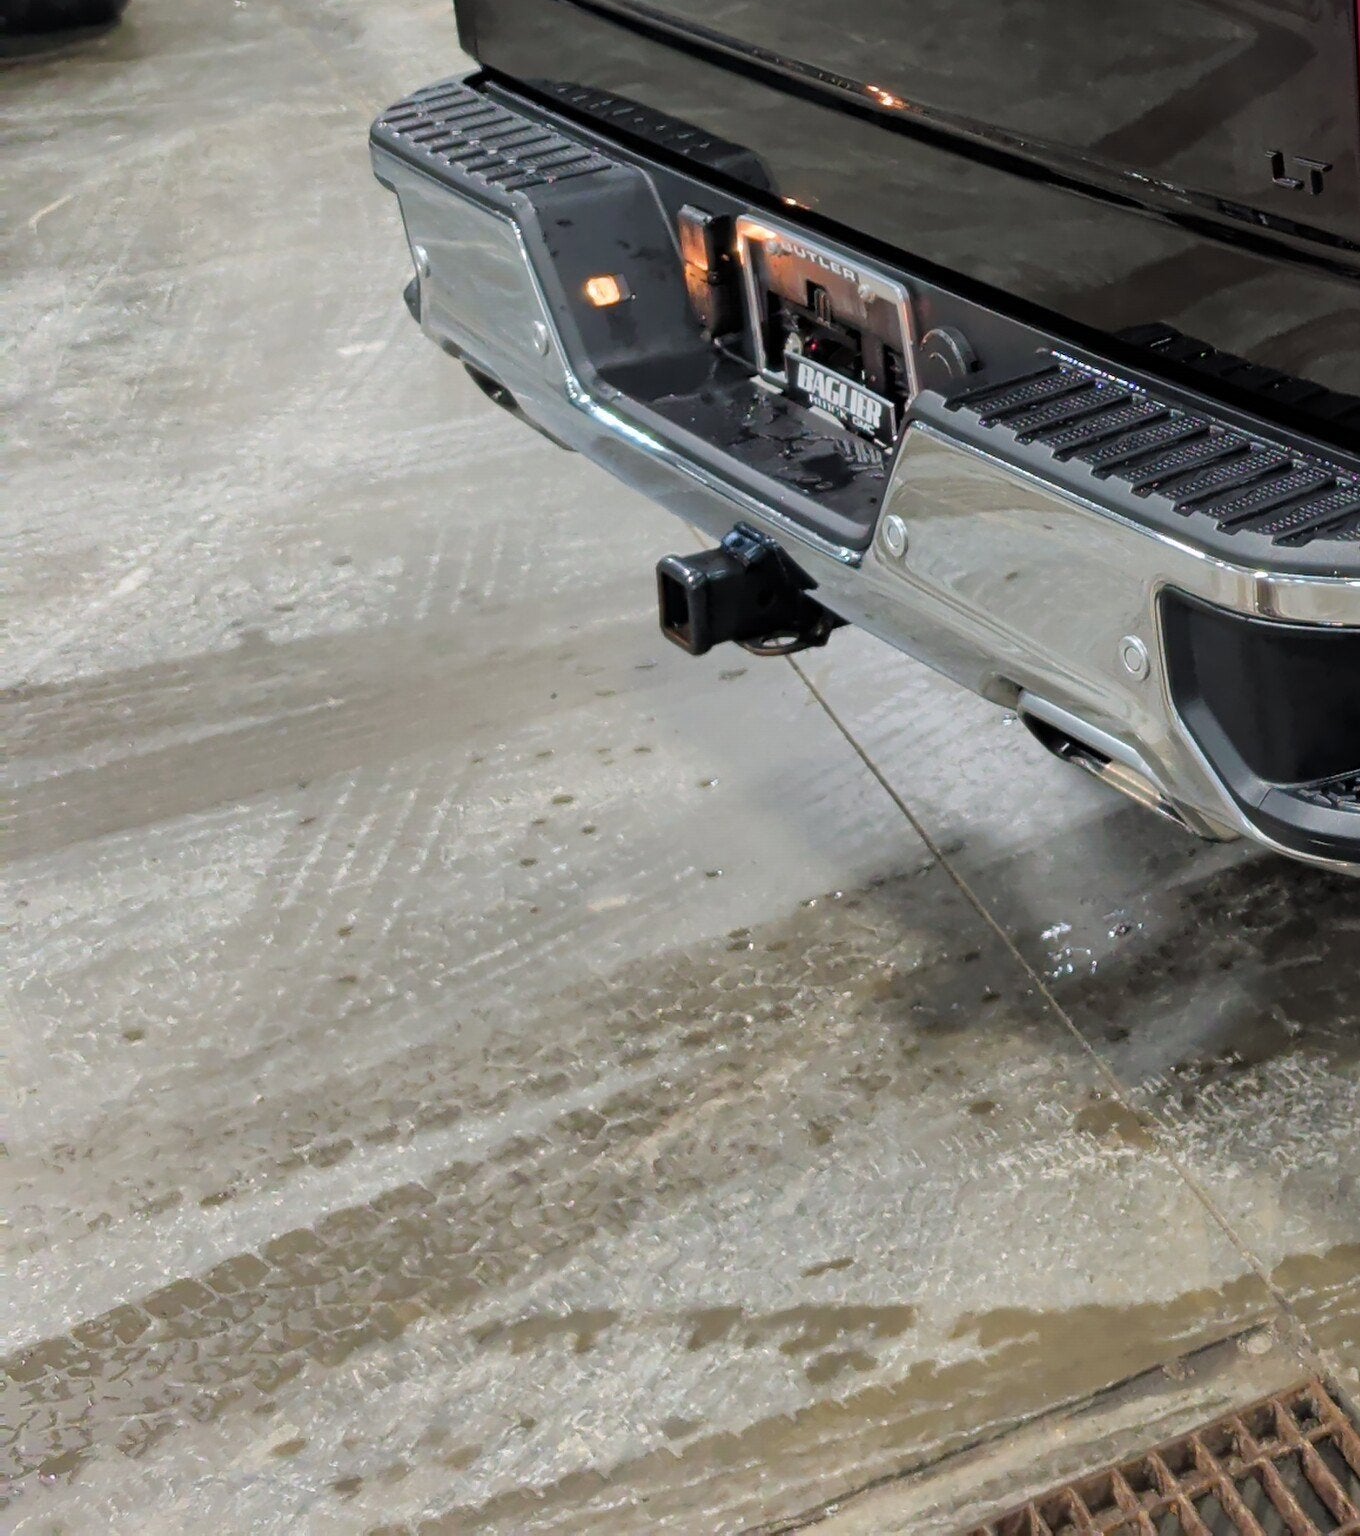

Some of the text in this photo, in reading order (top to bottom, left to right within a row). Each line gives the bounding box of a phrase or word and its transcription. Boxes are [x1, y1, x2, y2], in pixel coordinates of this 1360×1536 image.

[1265, 150, 1333, 195] LT
[780, 240, 856, 282] BUTLER
[797, 362, 882, 430] BAGLIER
